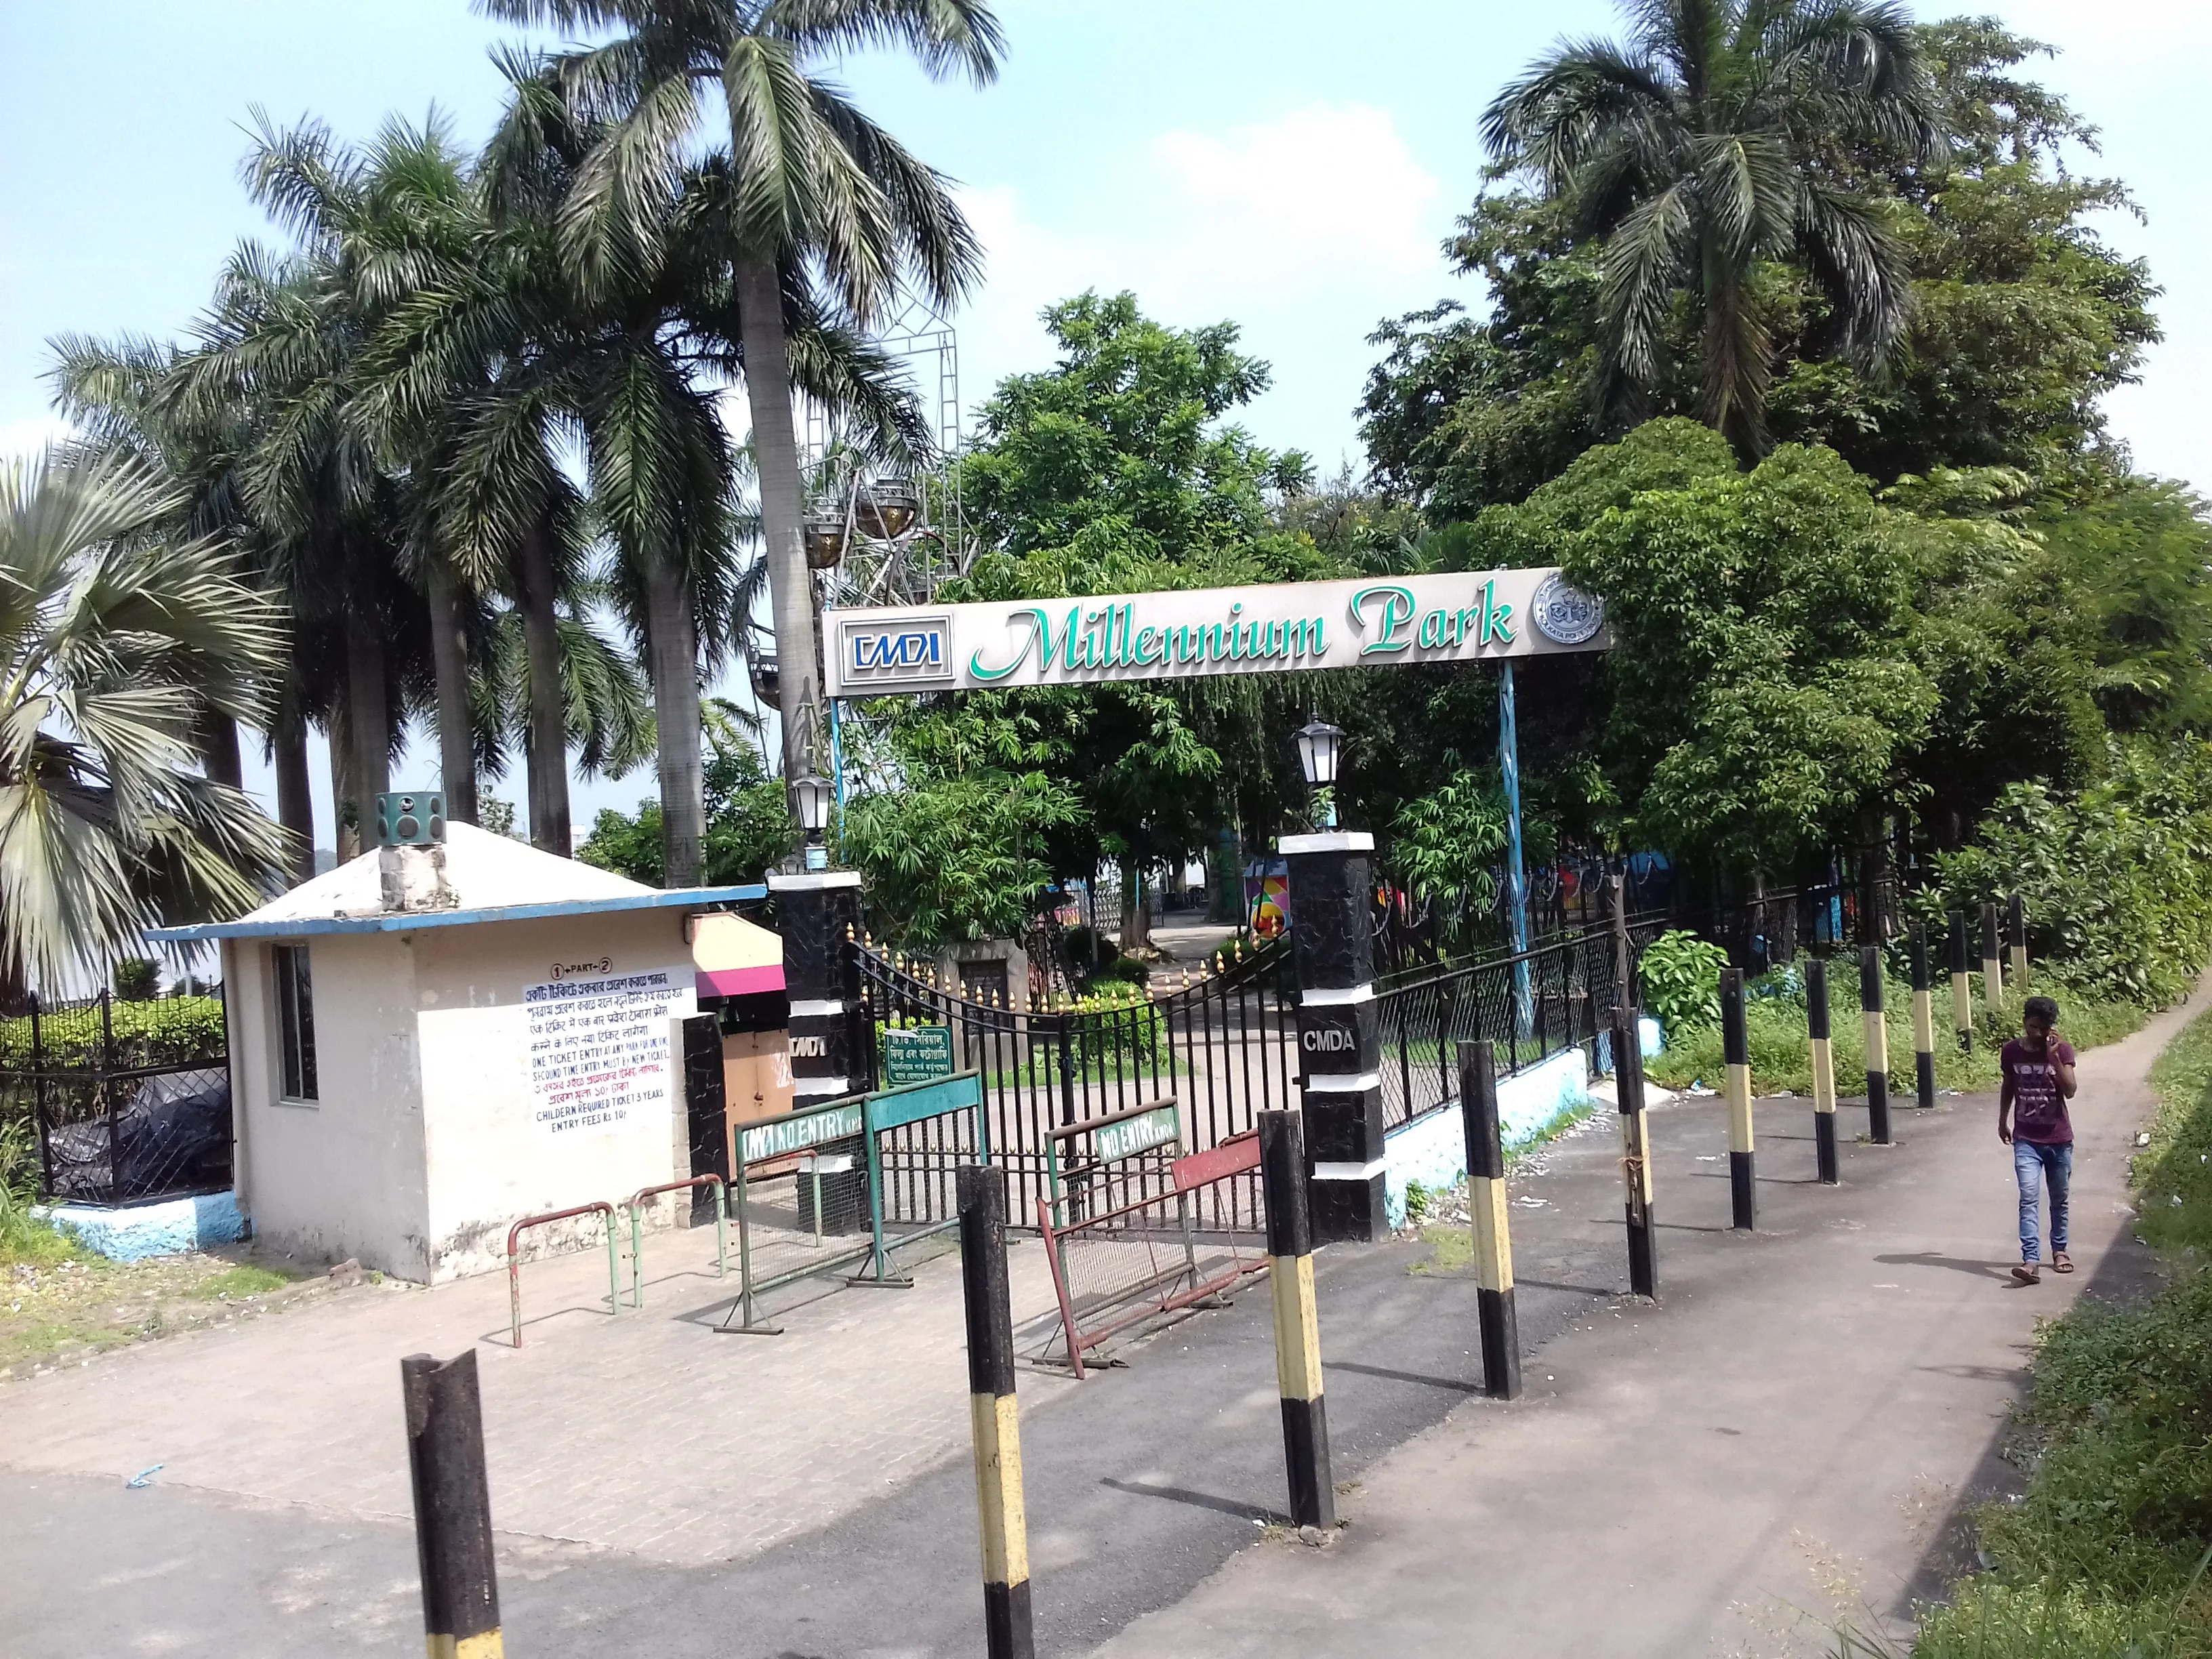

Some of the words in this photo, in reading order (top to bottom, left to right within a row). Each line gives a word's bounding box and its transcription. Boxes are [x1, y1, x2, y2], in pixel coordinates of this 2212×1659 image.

[969, 600, 1330, 681] Millennium
[1350, 577, 1519, 656] Park
[571, 963, 593, 973] PART
[526, 985, 548, 1002] একটি
[548, 983, 577, 998] টিকিটে
[578, 981, 605, 995] একবার
[607, 978, 628, 991] প্রবেশ
[530, 1025, 543, 1035] एक
[578, 1017, 591, 1027] एक
[581, 1034, 594, 1044] नया
[1304, 1029, 1355, 1051] CMDA
[533, 1056, 546, 1068] ONE
[549, 1051, 576, 1064] TICKET
[605, 1046, 611, 1055] AT
[533, 1068, 561, 1082] SECOUND
[563, 1065, 579, 1076] TIME
[581, 1061, 600, 1074] ENTRY
[603, 1057, 619, 1069] MUST
[632, 1053, 645, 1064] NEW
[537, 1105, 576, 1122] CHILDERN
[578, 1099, 610, 1114] REQUIRED
[612, 1094, 634, 1106] TICKET
[637, 1092, 642, 1102] 3
[643, 1088, 663, 1100] YEARS
[552, 1119, 579, 1133] ENTRY
[582, 1113, 601, 1126] FEES
[777, 1122, 794, 1150] NO
[798, 1111, 844, 1147] ENTRY
[1101, 1128, 1120, 1160] NO
[1120, 1115, 1153, 1153] ENTRY
